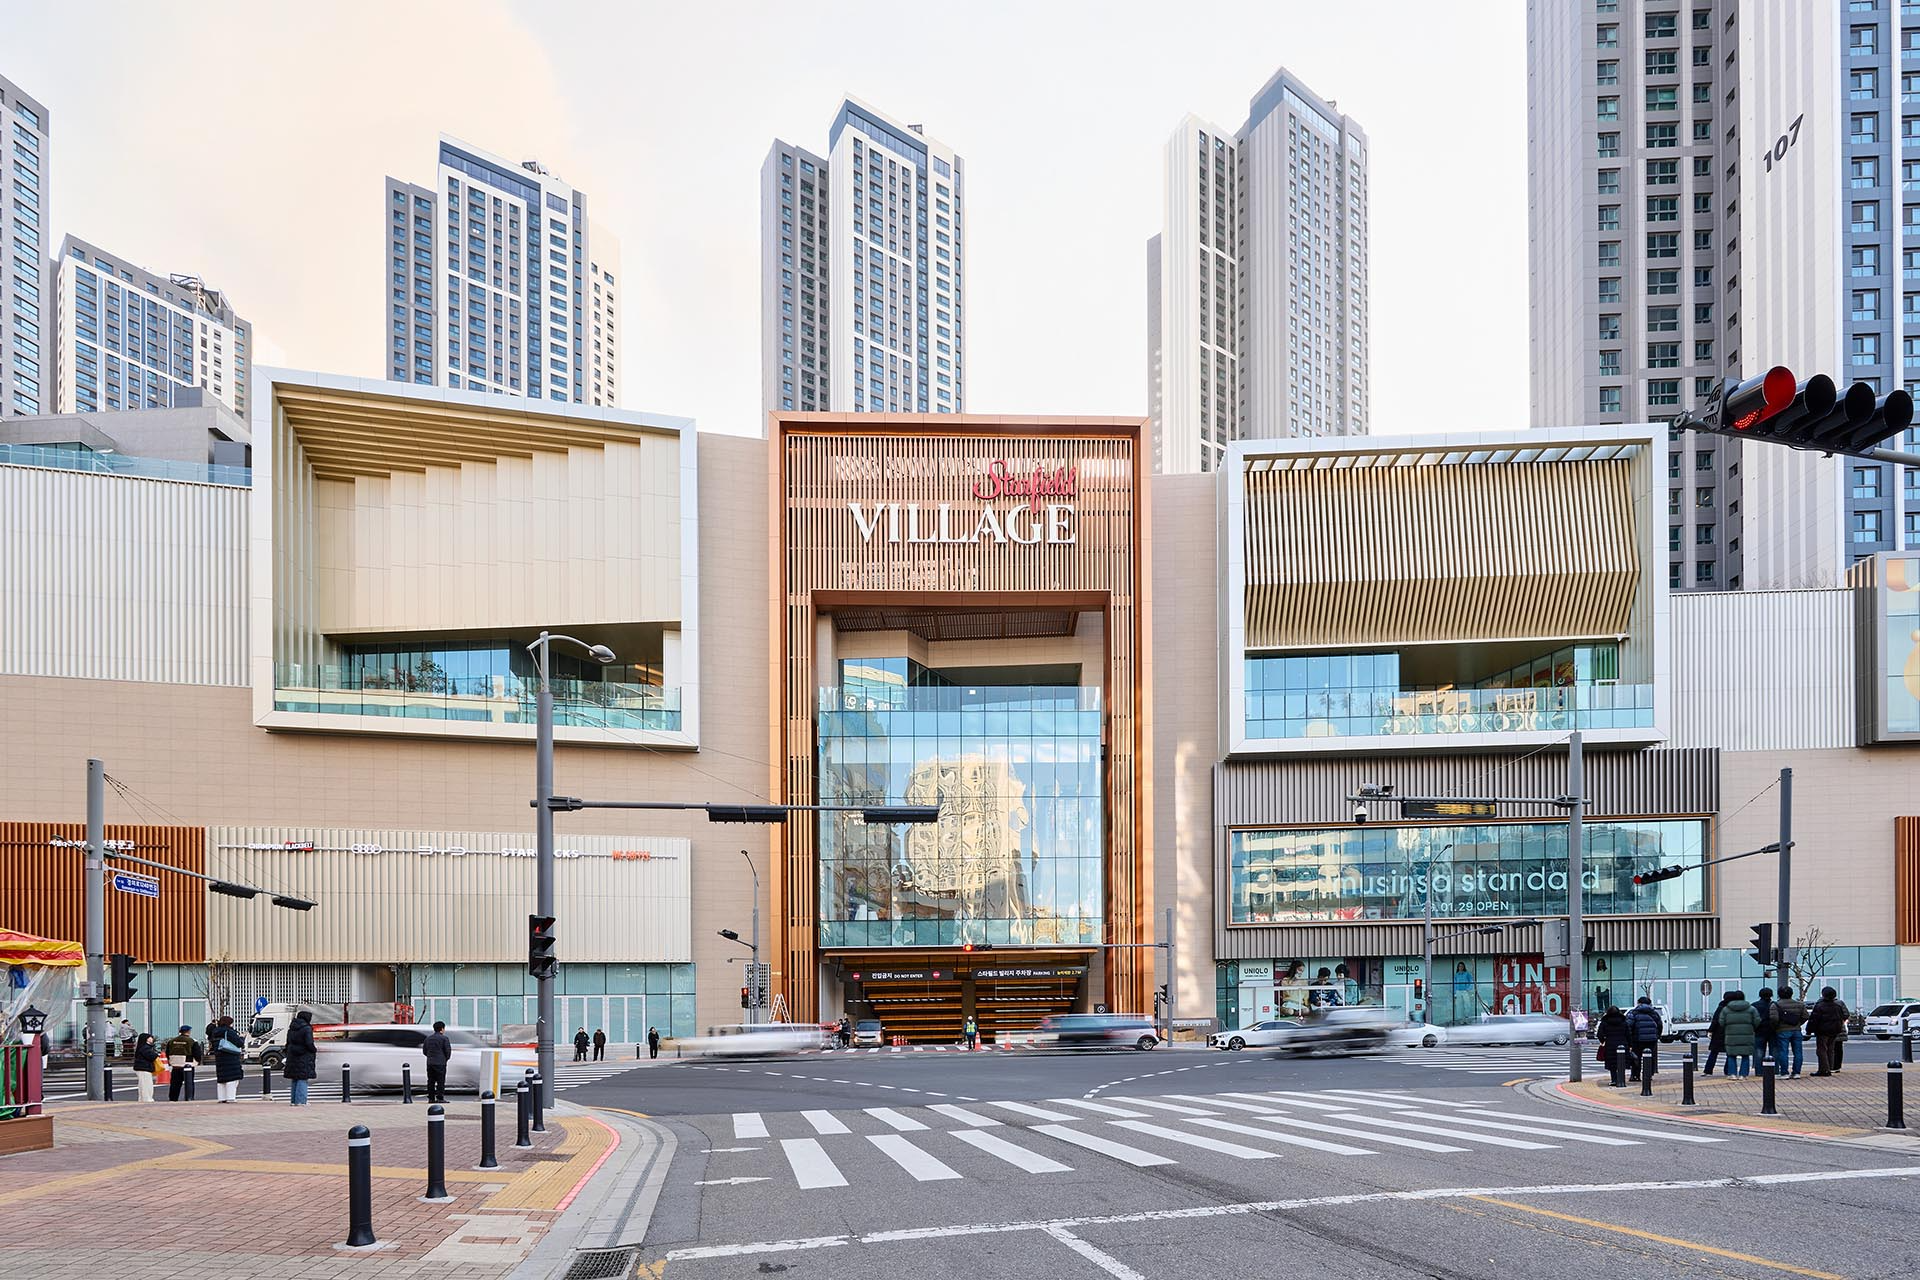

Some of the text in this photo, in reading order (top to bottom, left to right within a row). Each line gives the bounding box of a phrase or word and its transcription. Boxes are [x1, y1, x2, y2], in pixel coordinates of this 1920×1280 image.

[1763, 113, 1804, 173] 107
[973, 460, 1077, 514] Starfield
[847, 503, 1076, 545] VILLAGE
[418, 845, 466, 856] BYD
[501, 848, 580, 859] STARCKS
[1333, 865, 1599, 894] musinsa standad
[1477, 901, 1509, 911] OPEN
[1394, 965, 1419, 973] UNIQLO
[1502, 963, 1556, 988] UNI
